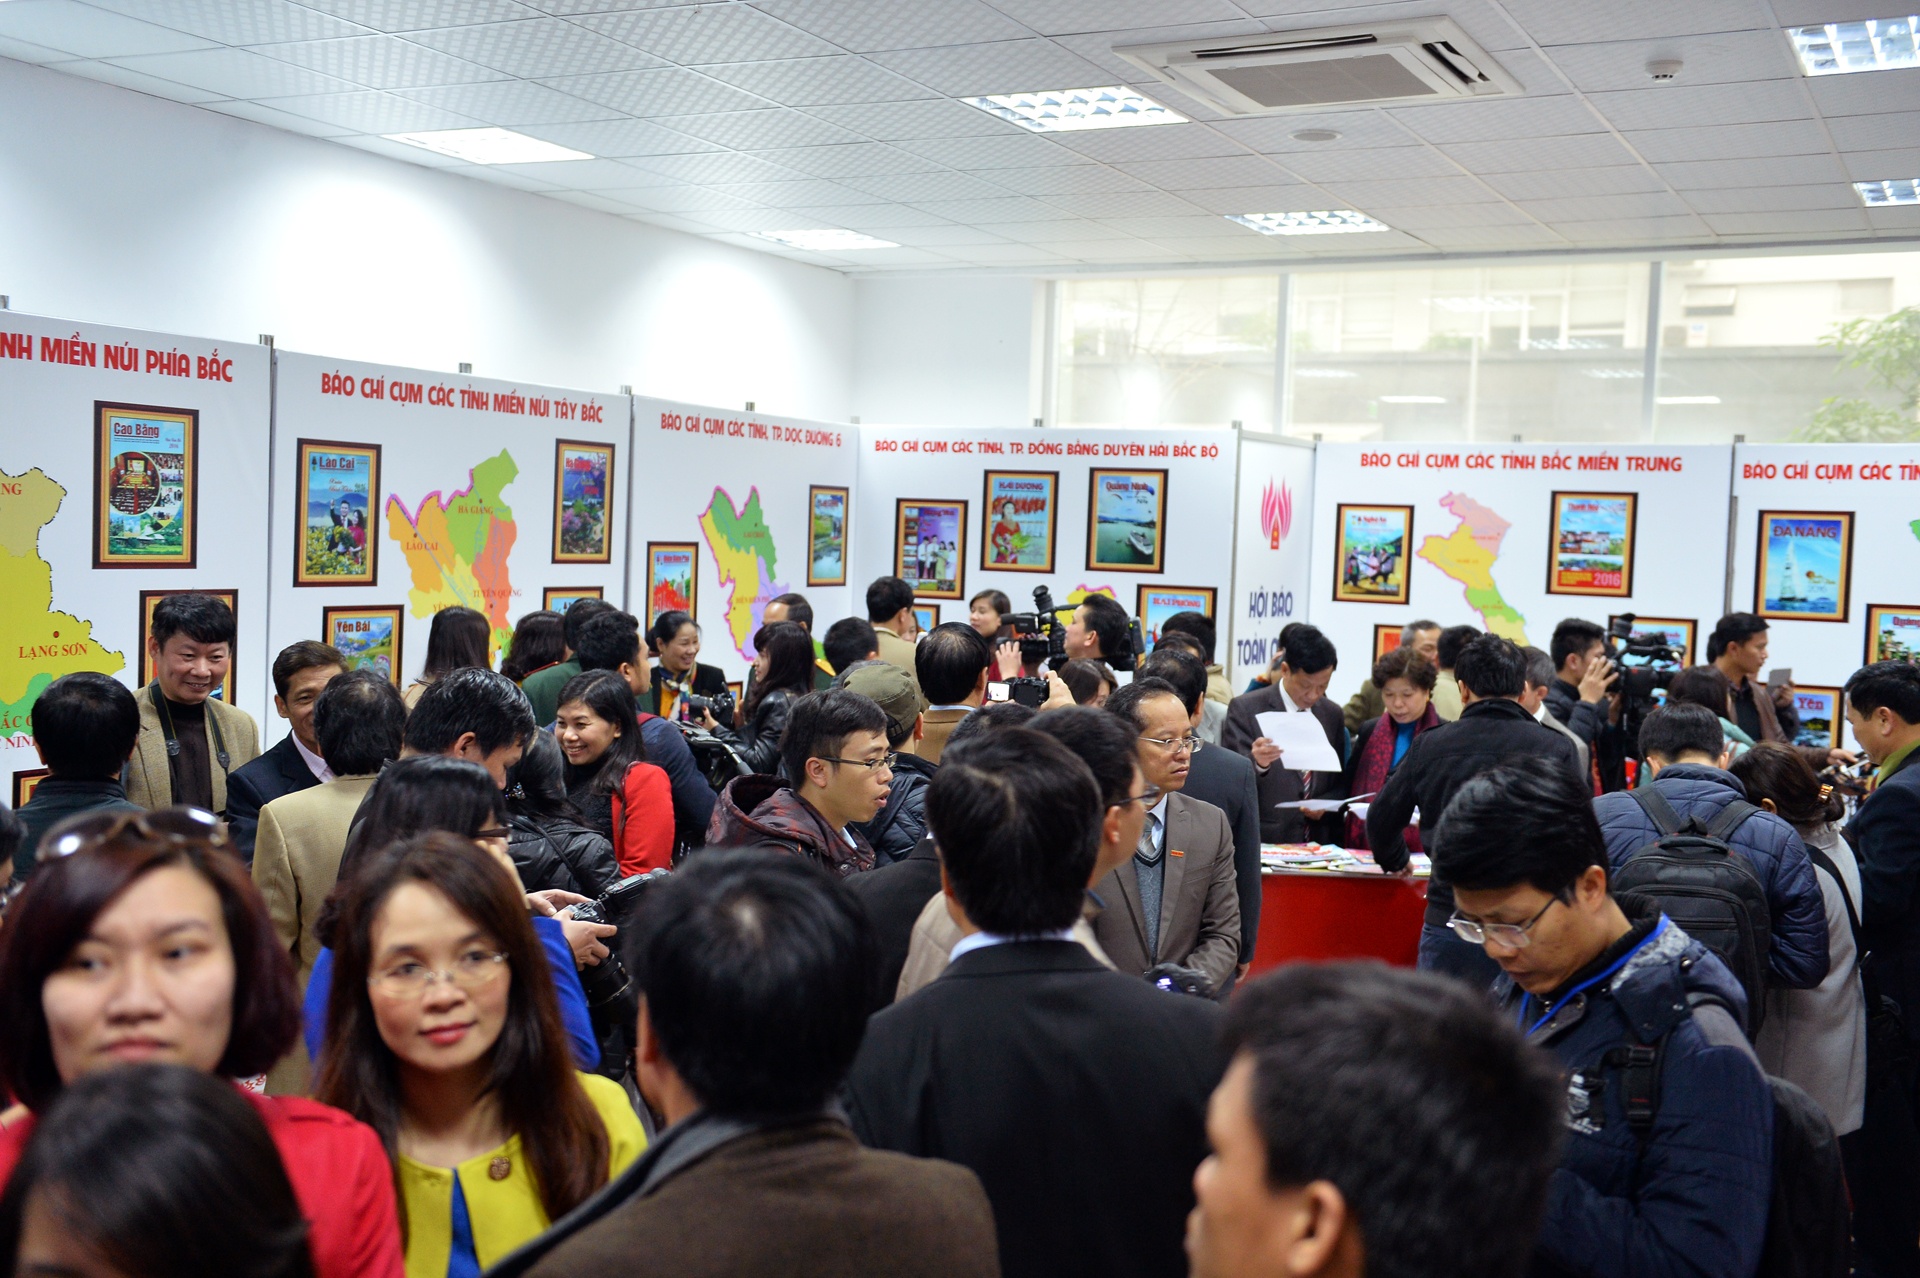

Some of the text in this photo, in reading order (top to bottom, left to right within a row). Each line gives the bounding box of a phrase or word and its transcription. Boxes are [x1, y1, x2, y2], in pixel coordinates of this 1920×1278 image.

[41, 332, 96, 367] MIỀN
[104, 341, 138, 372] NÚI
[146, 347, 190, 378] PHÍA
[197, 349, 233, 382] BẮC
[321, 370, 355, 396] BÁO
[361, 375, 384, 399] CHÍ
[390, 381, 423, 407] CỤM
[428, 382, 455, 407] CÁC
[459, 384, 489, 411] TỈNH
[529, 395, 550, 417] NÚI
[554, 397, 577, 420] TÂY
[581, 397, 603, 423] BẮC
[114, 422, 133, 435] Cao
[661, 410, 682, 431] BÁO
[685, 413, 700, 432] CHÍ
[703, 418, 724, 438] CỤM
[728, 417, 745, 437] CÁC
[836, 433, 841, 447] 6
[875, 437, 898, 451] BÁO
[902, 439, 918, 452] CHÍ
[923, 441, 948, 455] CỤM
[952, 439, 973, 454] CÁC
[1104, 441, 1145, 457] DUYÊN
[1201, 442, 1218, 461] BỘ
[1361, 450, 1391, 467] BÁO
[1397, 450, 1420, 468] CHÍ
[1425, 454, 1460, 472] CỤM
[1465, 451, 1495, 469] CÁC
[1501, 450, 1536, 469] TỈNH
[1541, 449, 1572, 470] BẮC
[1626, 456, 1682, 472] TRUNG
[339, 457, 355, 469] Cai
[1743, 460, 1777, 479] BÁO
[1783, 460, 1809, 479] CHÍ
[1815, 464, 1853, 484] CỤM
[1859, 460, 1892, 480] CÁC
[1593, 572, 1621, 587] 2016
[1249, 585, 1293, 625] HỘI BÁO
[337, 621, 370, 632] Yên Bái
[19, 642, 87, 660] LẠNG SƠN
[1237, 633, 1267, 666] TOÀN
[1798, 697, 1824, 710] Yên
